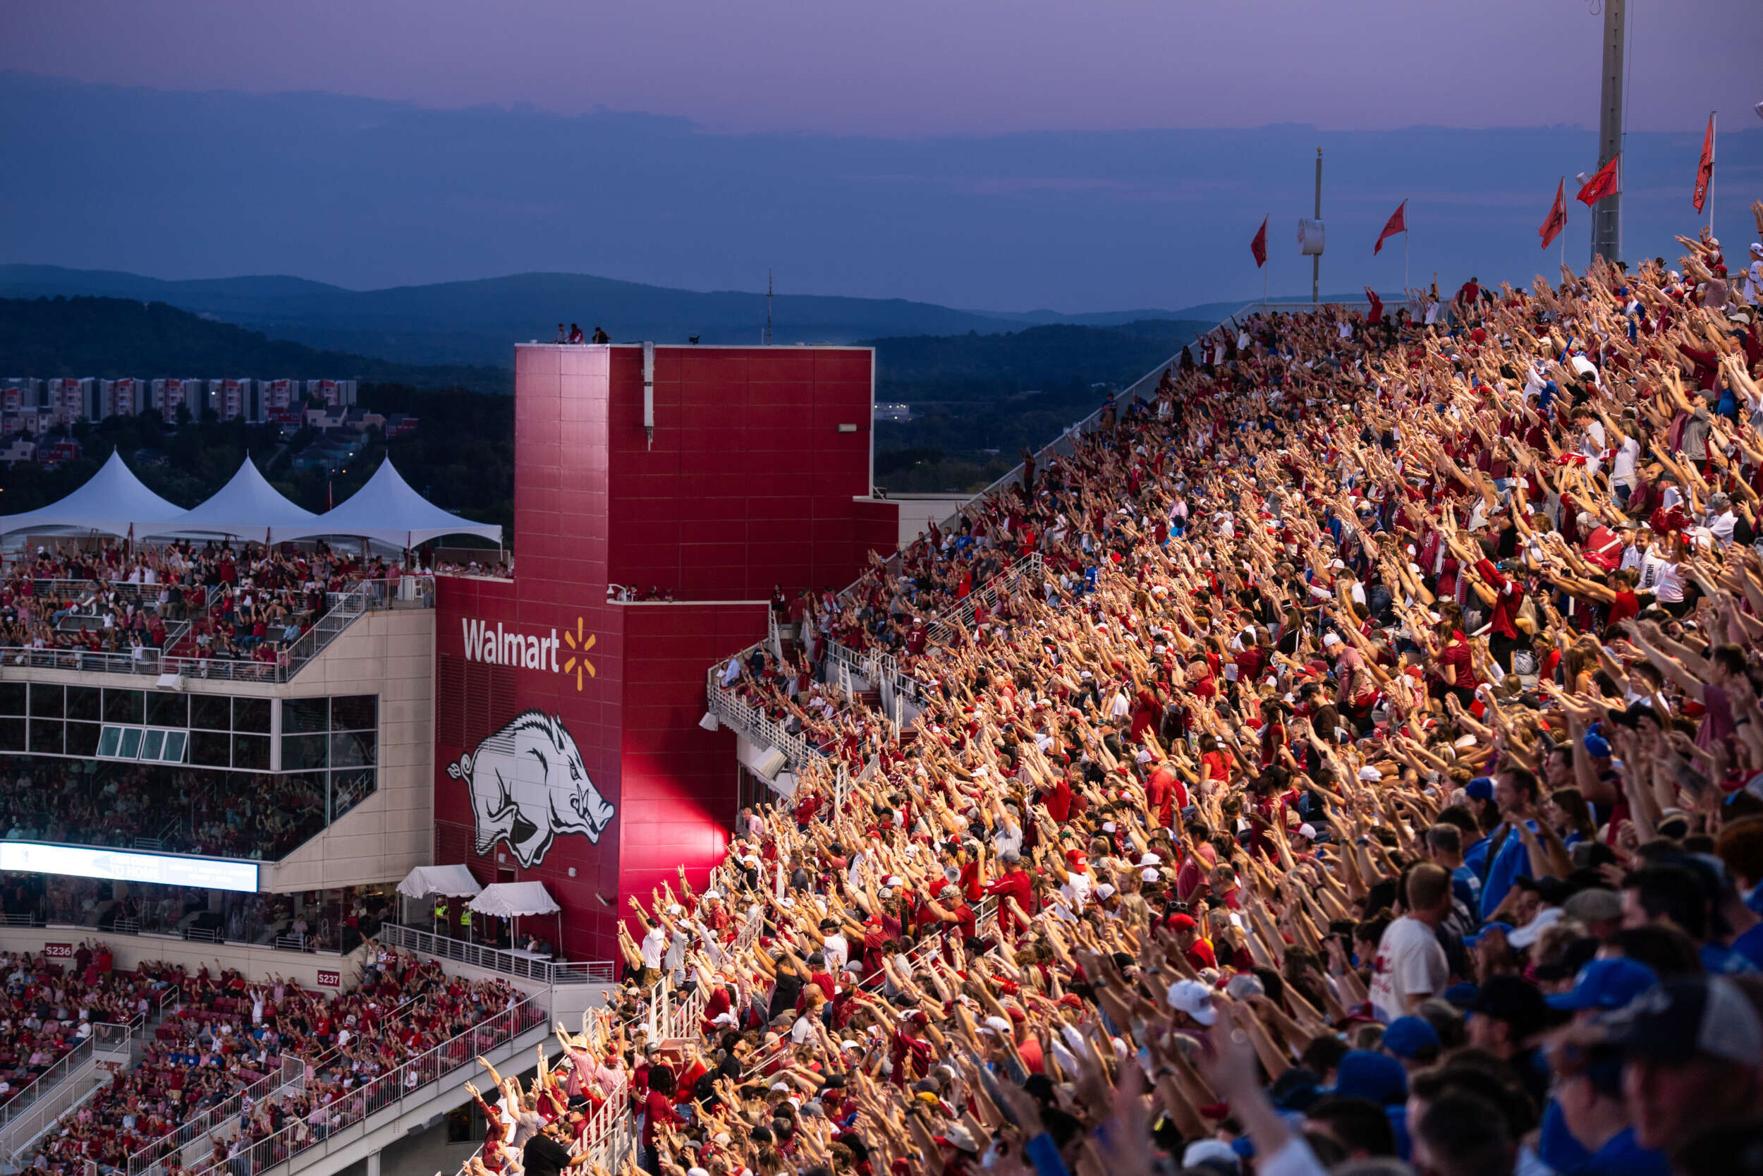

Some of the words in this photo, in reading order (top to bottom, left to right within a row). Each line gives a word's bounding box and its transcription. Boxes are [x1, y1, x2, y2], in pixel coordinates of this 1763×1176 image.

[462, 617, 559, 673] Walmart
[46, 946, 71, 956] S236
[319, 974, 339, 984] S237
